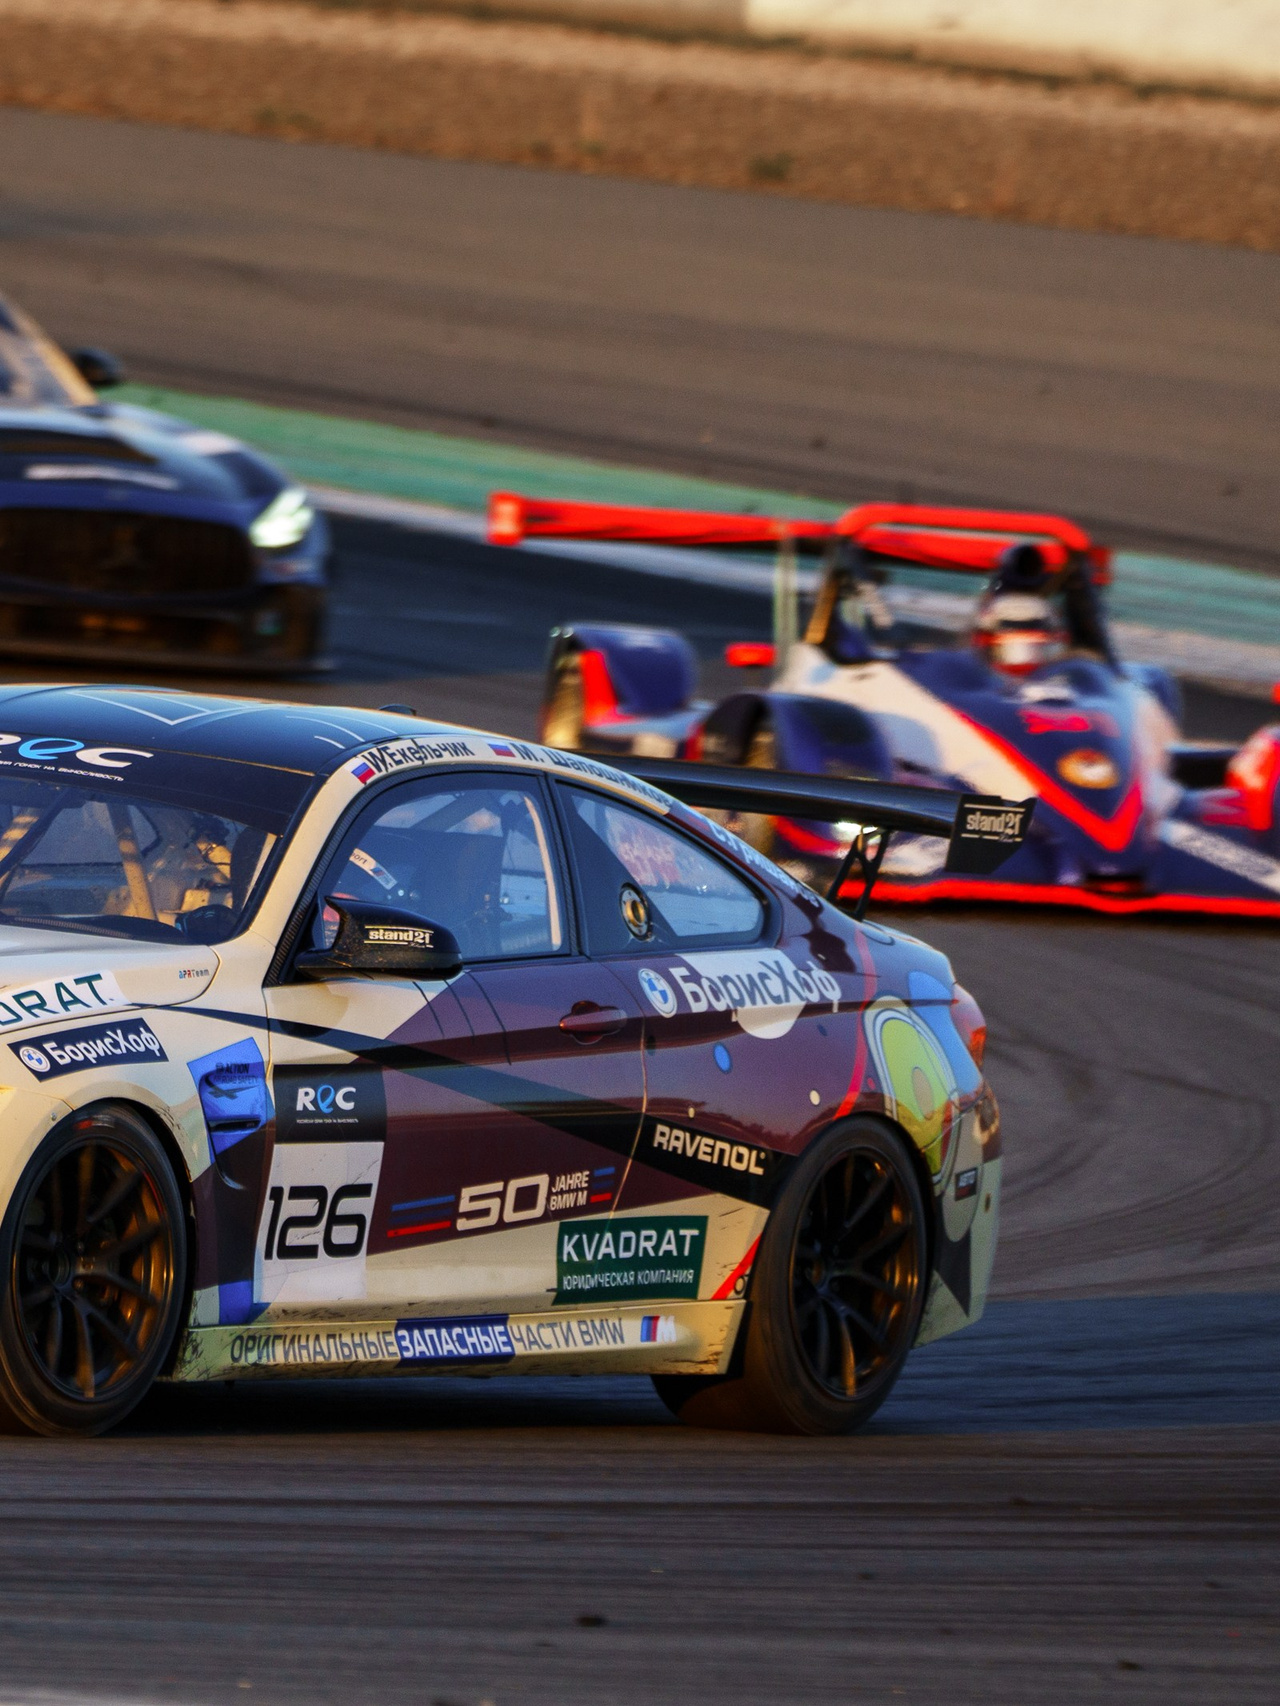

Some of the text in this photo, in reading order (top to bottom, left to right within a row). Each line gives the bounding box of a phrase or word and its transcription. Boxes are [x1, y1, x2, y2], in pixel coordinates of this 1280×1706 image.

[966, 811, 1024, 835] stand21
[368, 928, 432, 944] stand21
[668, 960, 842, 1014] БорисХоф
[47, 1027, 159, 1066] БорисХоф
[654, 1123, 765, 1176] RAVENOL
[551, 1170, 590, 1193] JAHRE
[456, 1173, 549, 1231] 50
[550, 1190, 588, 1211] BMW M
[264, 1185, 373, 1260] 126
[563, 1229, 700, 1263] KVADRAT
[563, 1269, 695, 1292] ЮРИДИЧЕСКАЯ КОМПАНИЯ
[230, 1317, 626, 1364] ОРИГИНАЛЬНЫЕ ЗАПАСНЫЕ ЧАСТИ BMW
